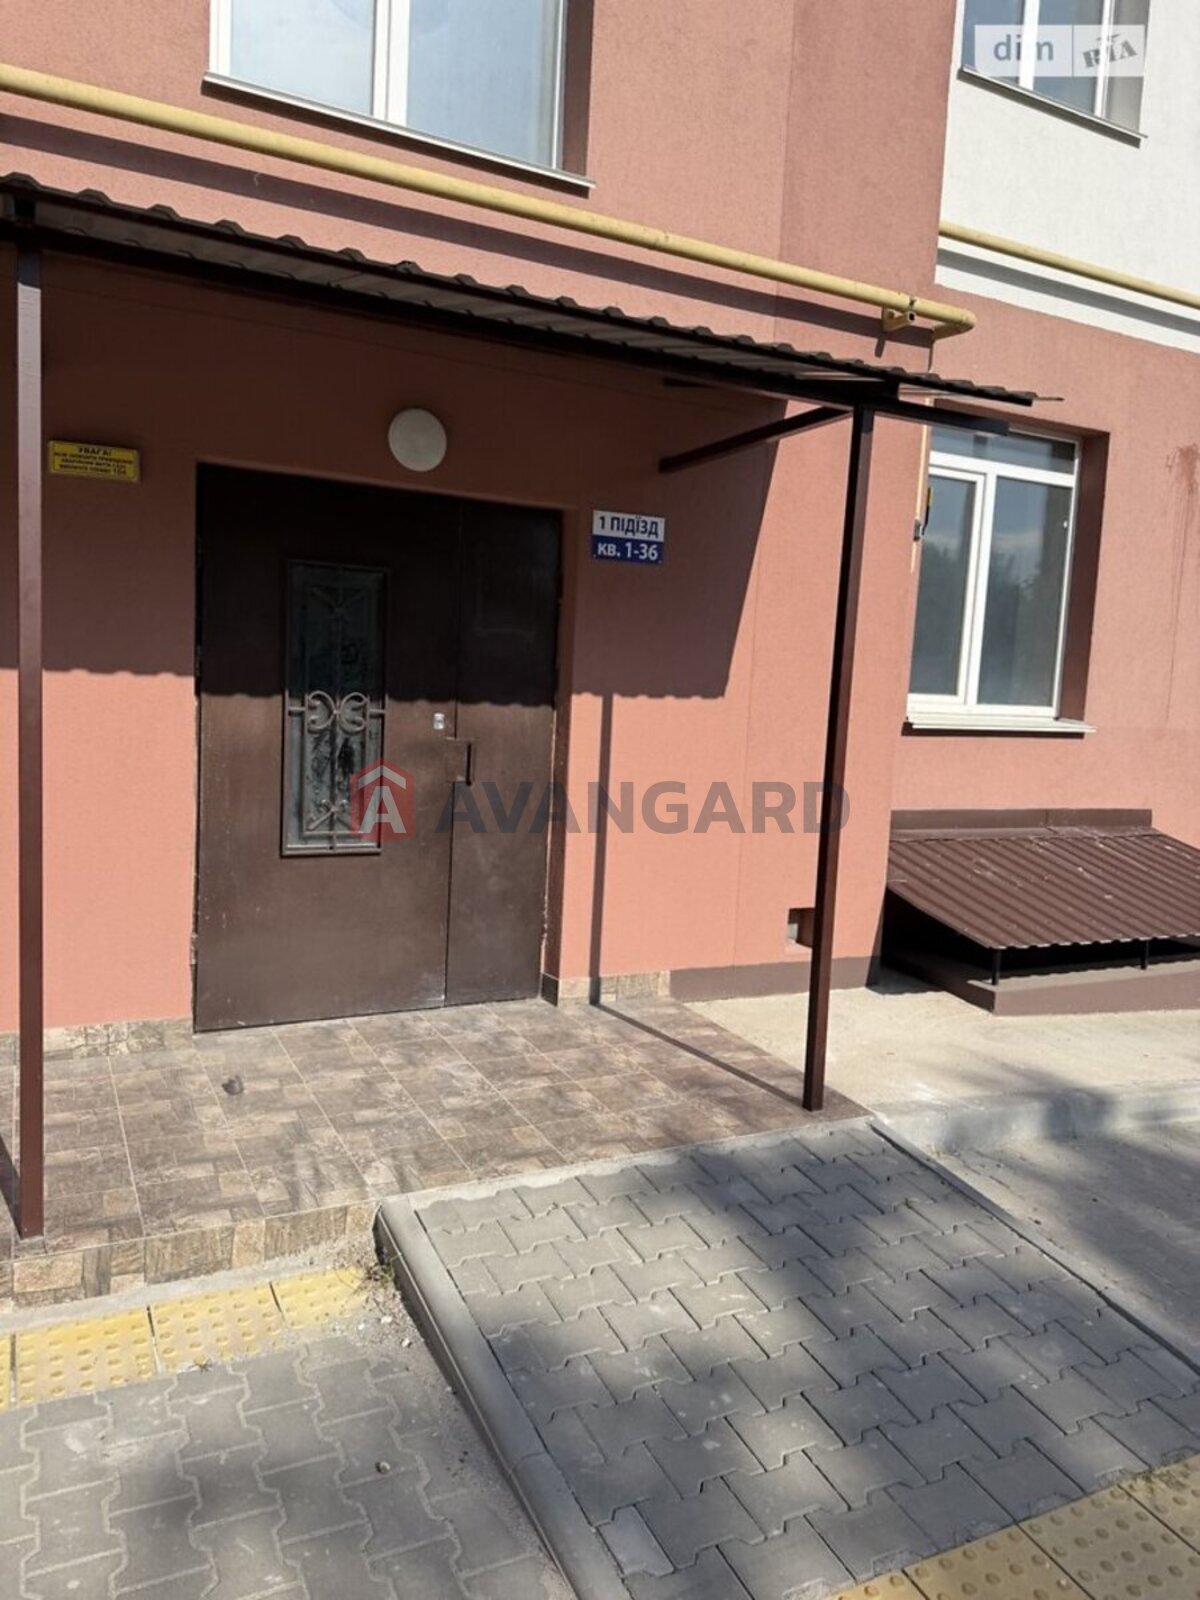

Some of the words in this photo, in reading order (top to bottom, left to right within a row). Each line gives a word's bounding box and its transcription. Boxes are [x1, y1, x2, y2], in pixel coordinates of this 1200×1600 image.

[599, 516, 605, 530] 1
[610, 514, 659, 539] ПІДЇЗД
[625, 541, 659, 561] 1-36
